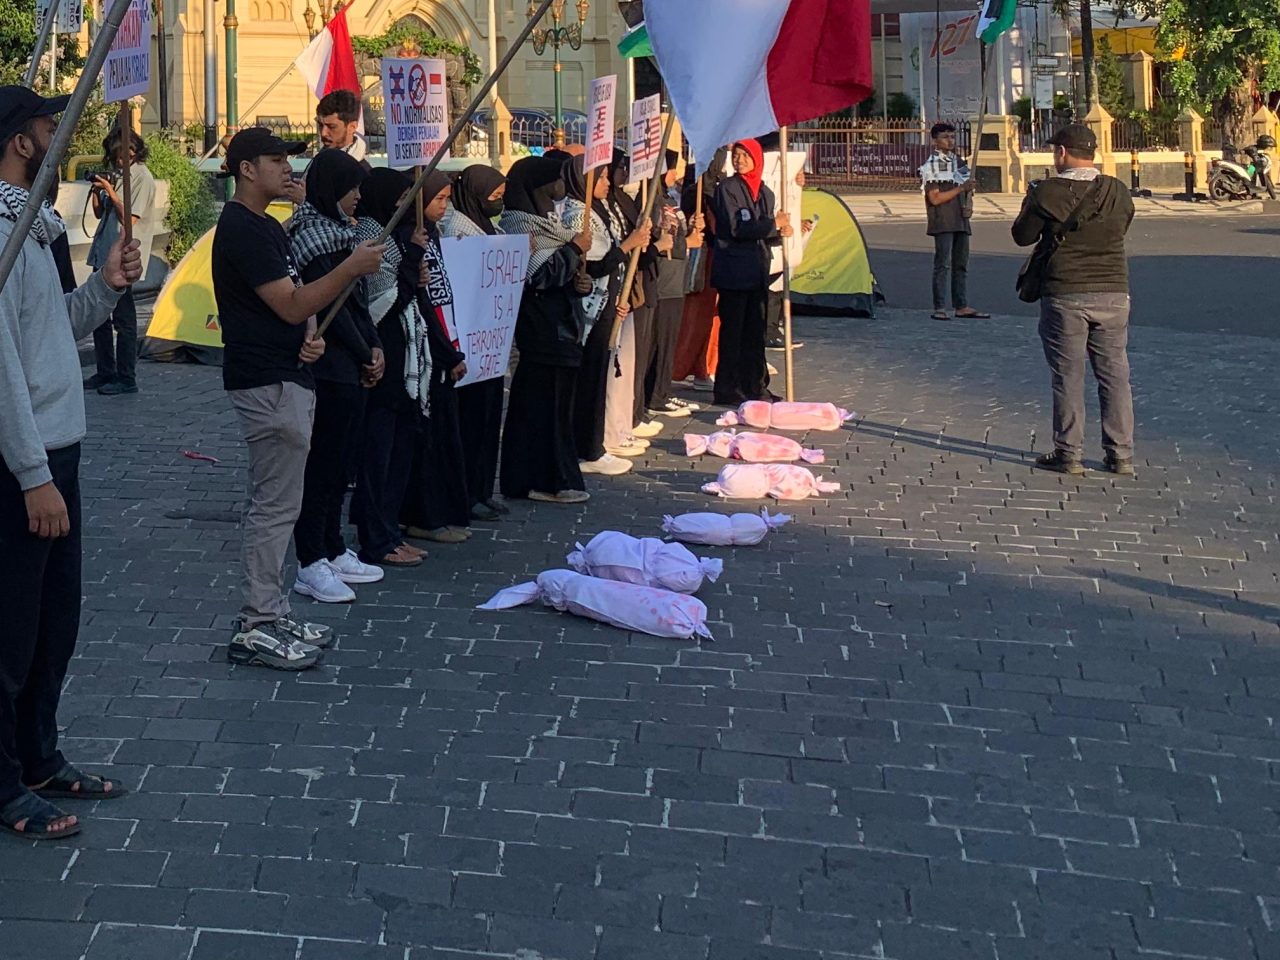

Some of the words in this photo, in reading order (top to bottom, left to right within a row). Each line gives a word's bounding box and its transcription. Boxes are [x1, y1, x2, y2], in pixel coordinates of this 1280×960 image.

[405, 105, 443, 123] NORMALISASI
[398, 126, 417, 141] DENGAN
[395, 144, 401, 160] DI
[402, 143, 422, 159] SEKTOR
[481, 249, 527, 288] ISRAEL
[494, 295, 503, 320] IS
[507, 293, 514, 318] A
[466, 326, 510, 360] TERRORIST
[476, 353, 501, 379] STATE
